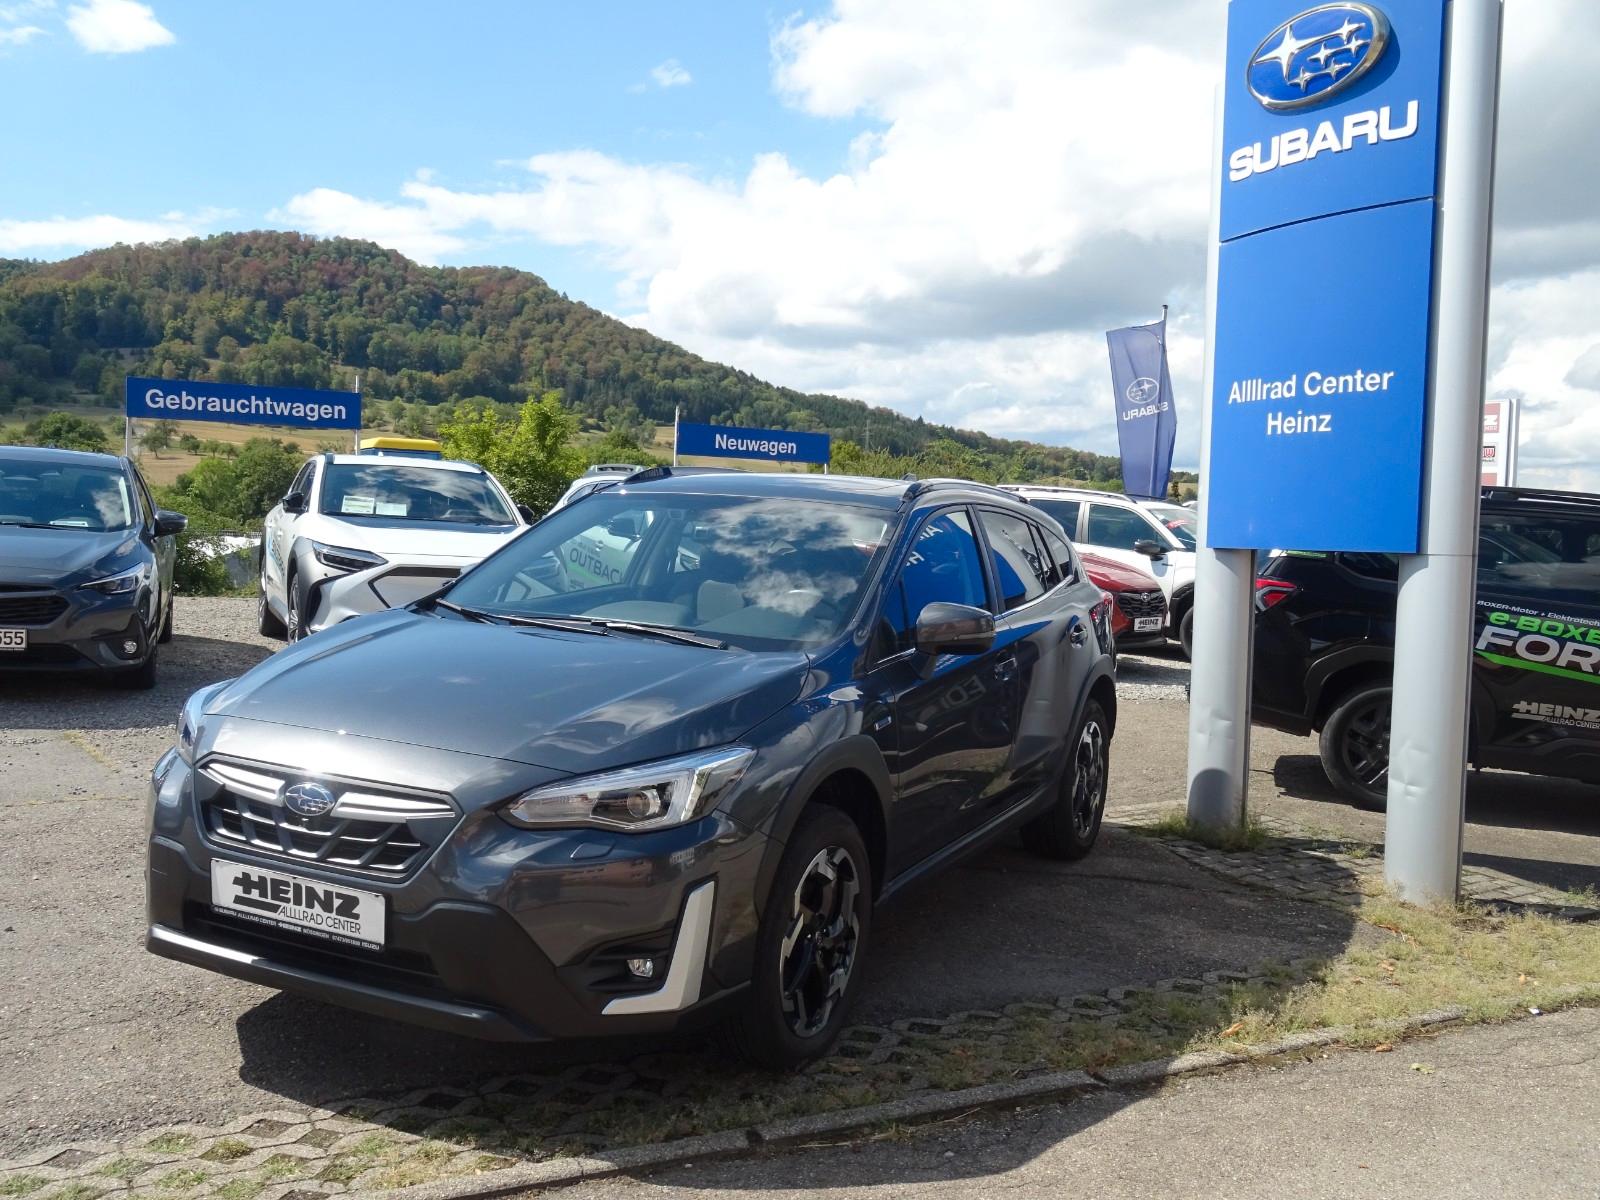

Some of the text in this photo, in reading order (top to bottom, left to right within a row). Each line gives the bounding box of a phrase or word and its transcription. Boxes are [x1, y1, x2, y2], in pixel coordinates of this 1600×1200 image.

[1229, 100, 1419, 182] SUBARU
[1304, 370, 1394, 396] Center
[145, 388, 347, 421] Gebrauchtwagen
[1266, 410, 1332, 435] Heinz
[715, 433, 797, 456] Neuwagen
[569, 547, 624, 585] OUTBAC
[0, 631, 24, 645] 55
[1475, 625, 1600, 674] FOR
[232, 871, 361, 921] HEINZ
[325, 915, 361, 935] CENTER
